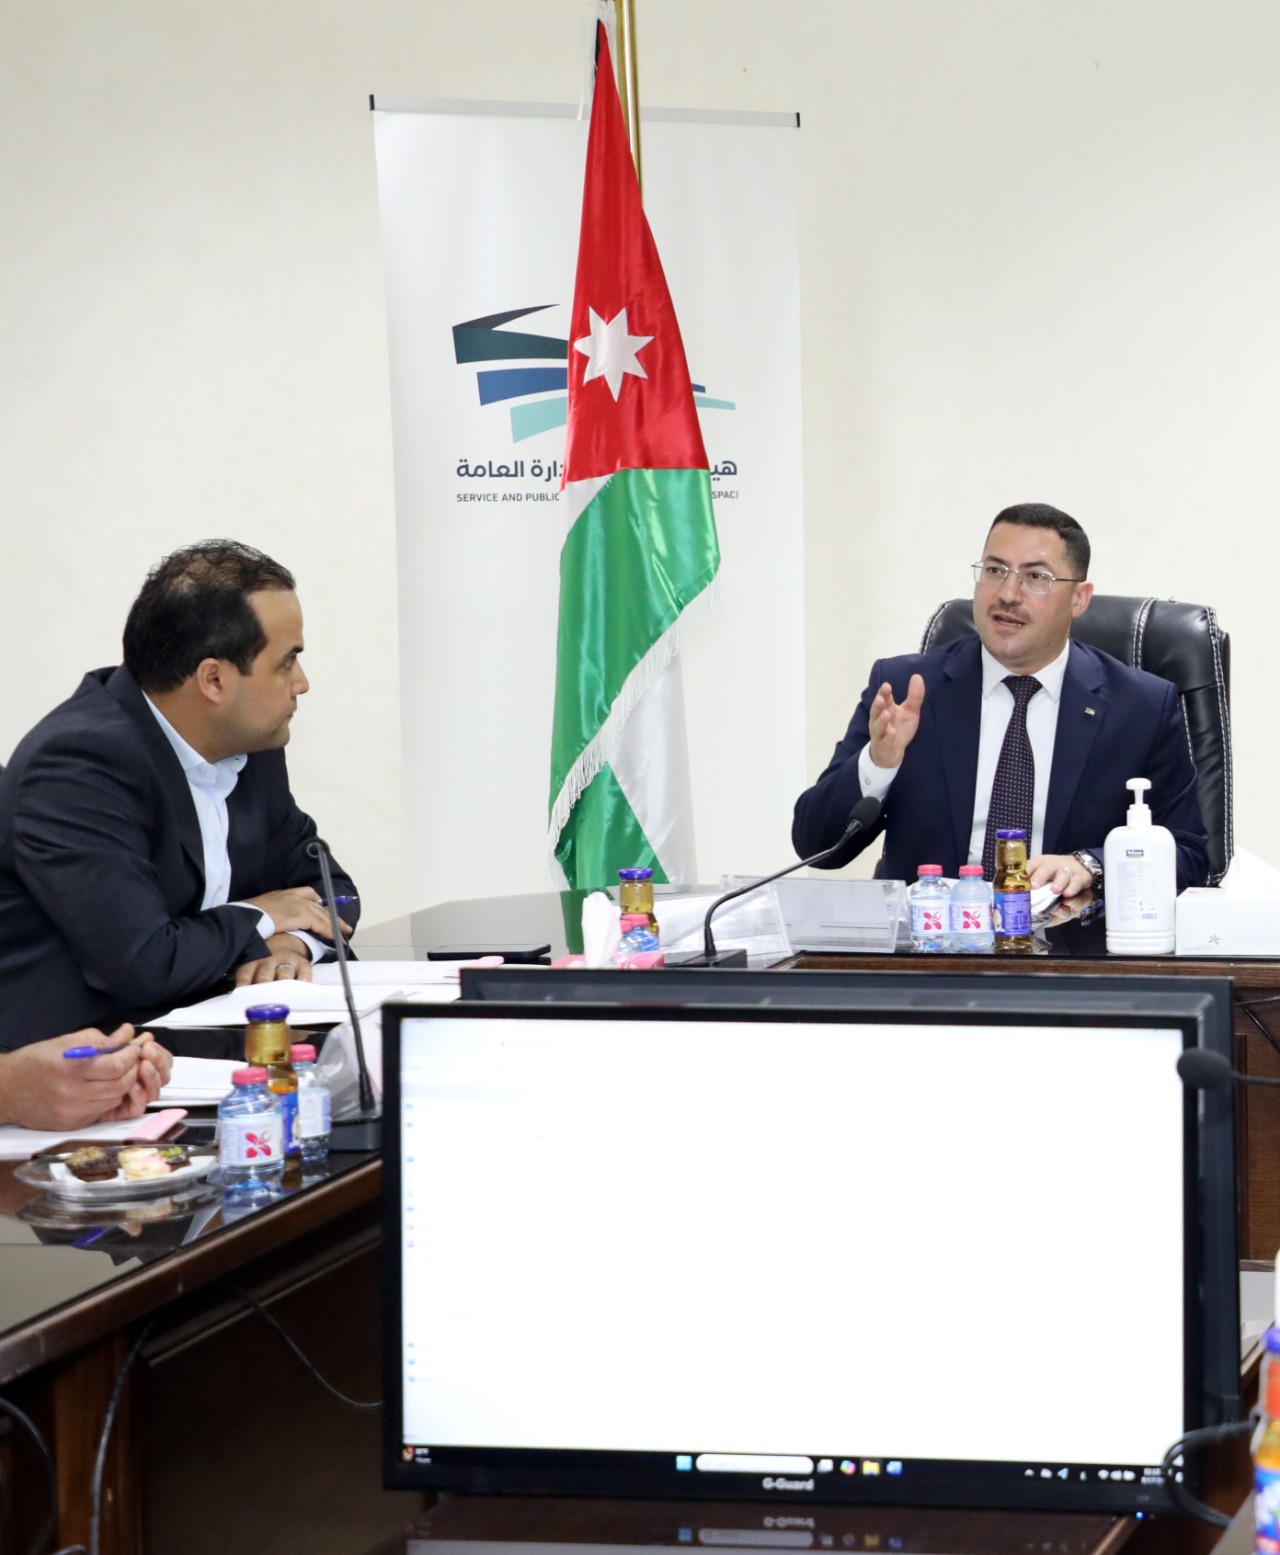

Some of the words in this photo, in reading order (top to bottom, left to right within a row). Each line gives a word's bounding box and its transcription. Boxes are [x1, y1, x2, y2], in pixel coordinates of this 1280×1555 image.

[456, 459, 525, 478] العامة
[456, 493, 499, 502] SERVICE
[502, 493, 523, 501] AND
